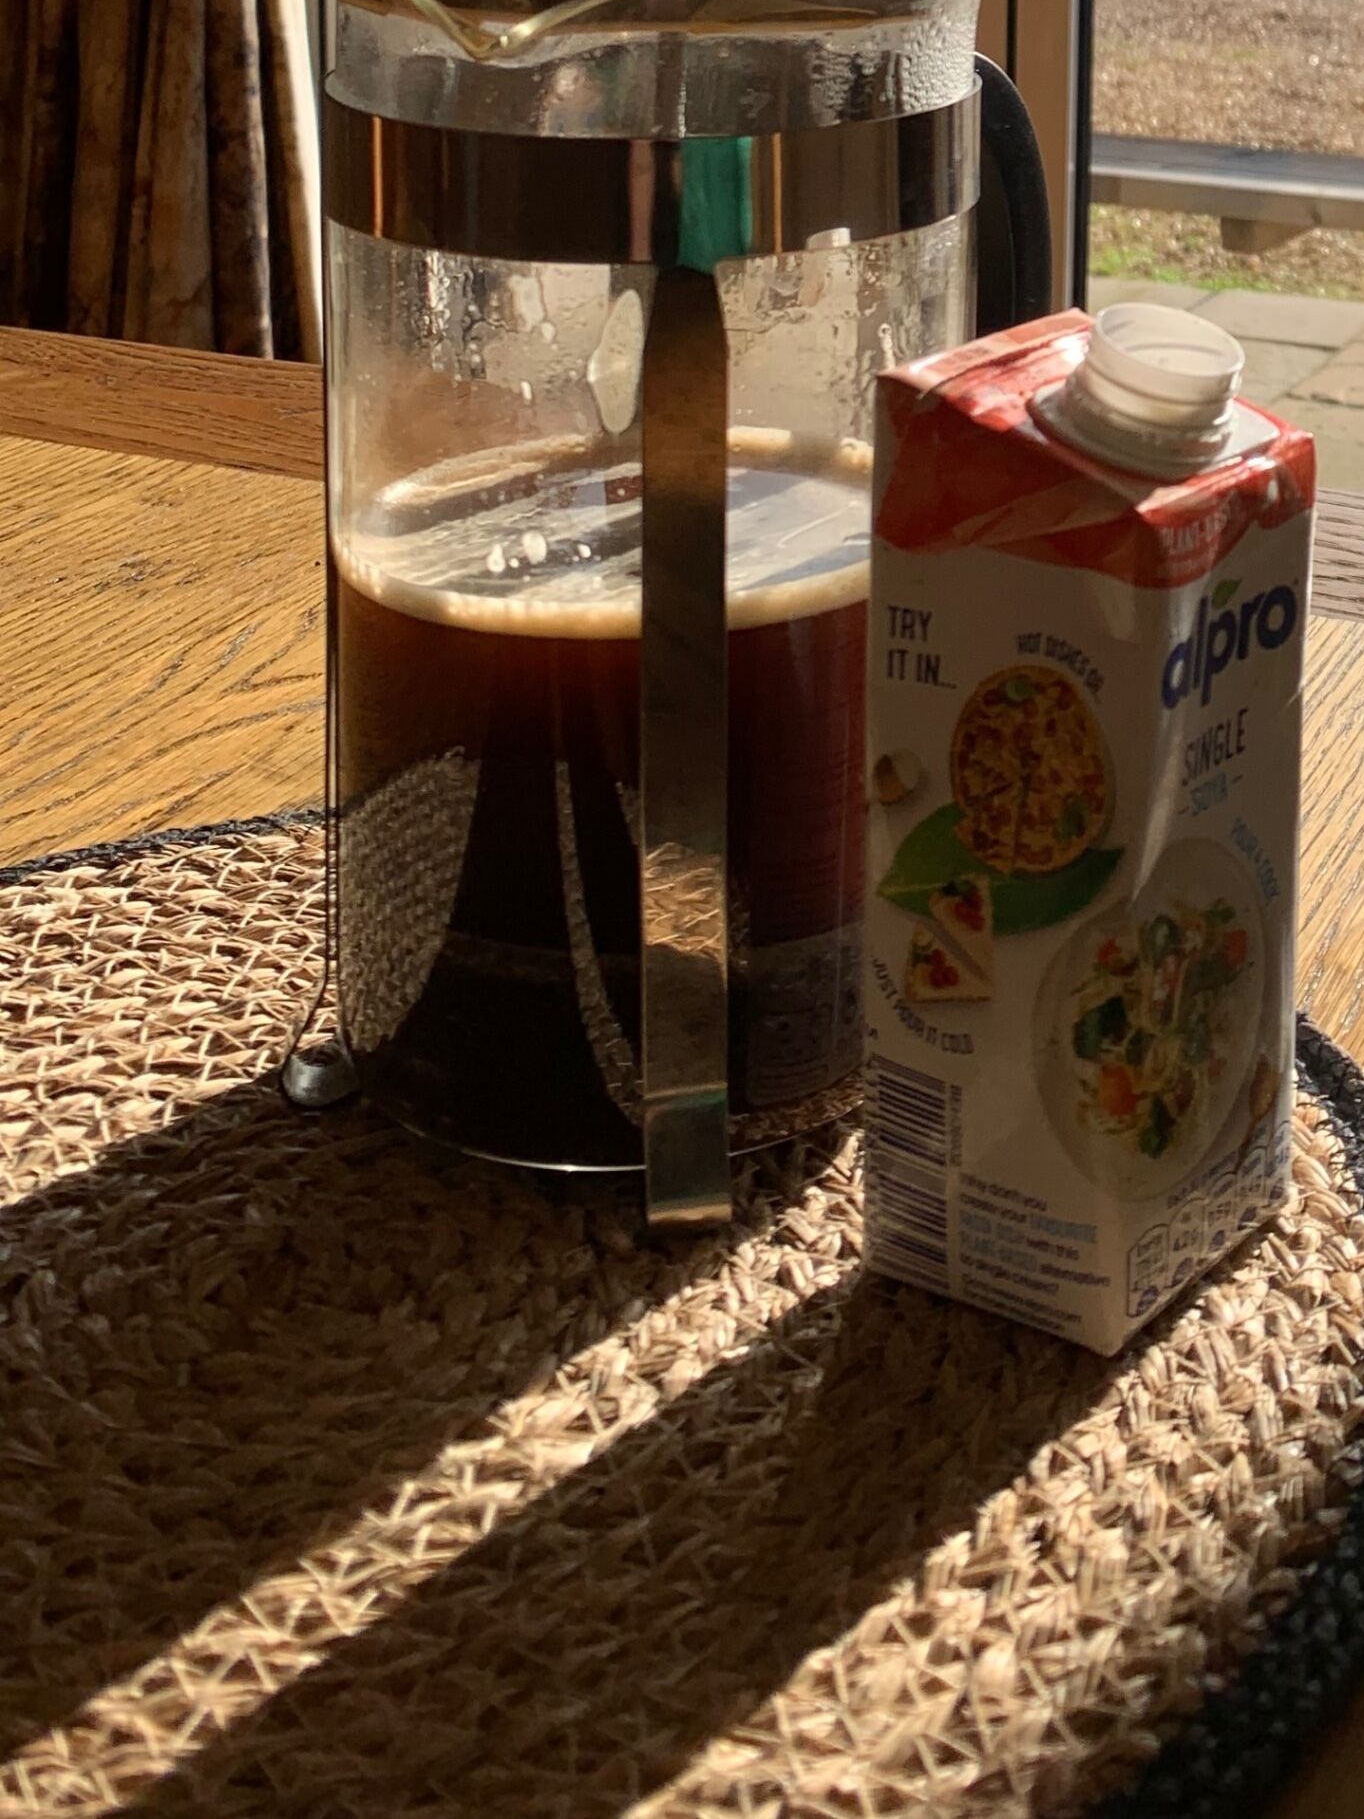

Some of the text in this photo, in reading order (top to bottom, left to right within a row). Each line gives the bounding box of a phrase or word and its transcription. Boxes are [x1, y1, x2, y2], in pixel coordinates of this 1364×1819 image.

[887, 605, 932, 642] TRY
[887, 649, 909, 681] IT
[1162, 585, 1297, 709] alpro
[1181, 708, 1248, 787] SINGLE
[872, 958, 898, 1000] JUST
